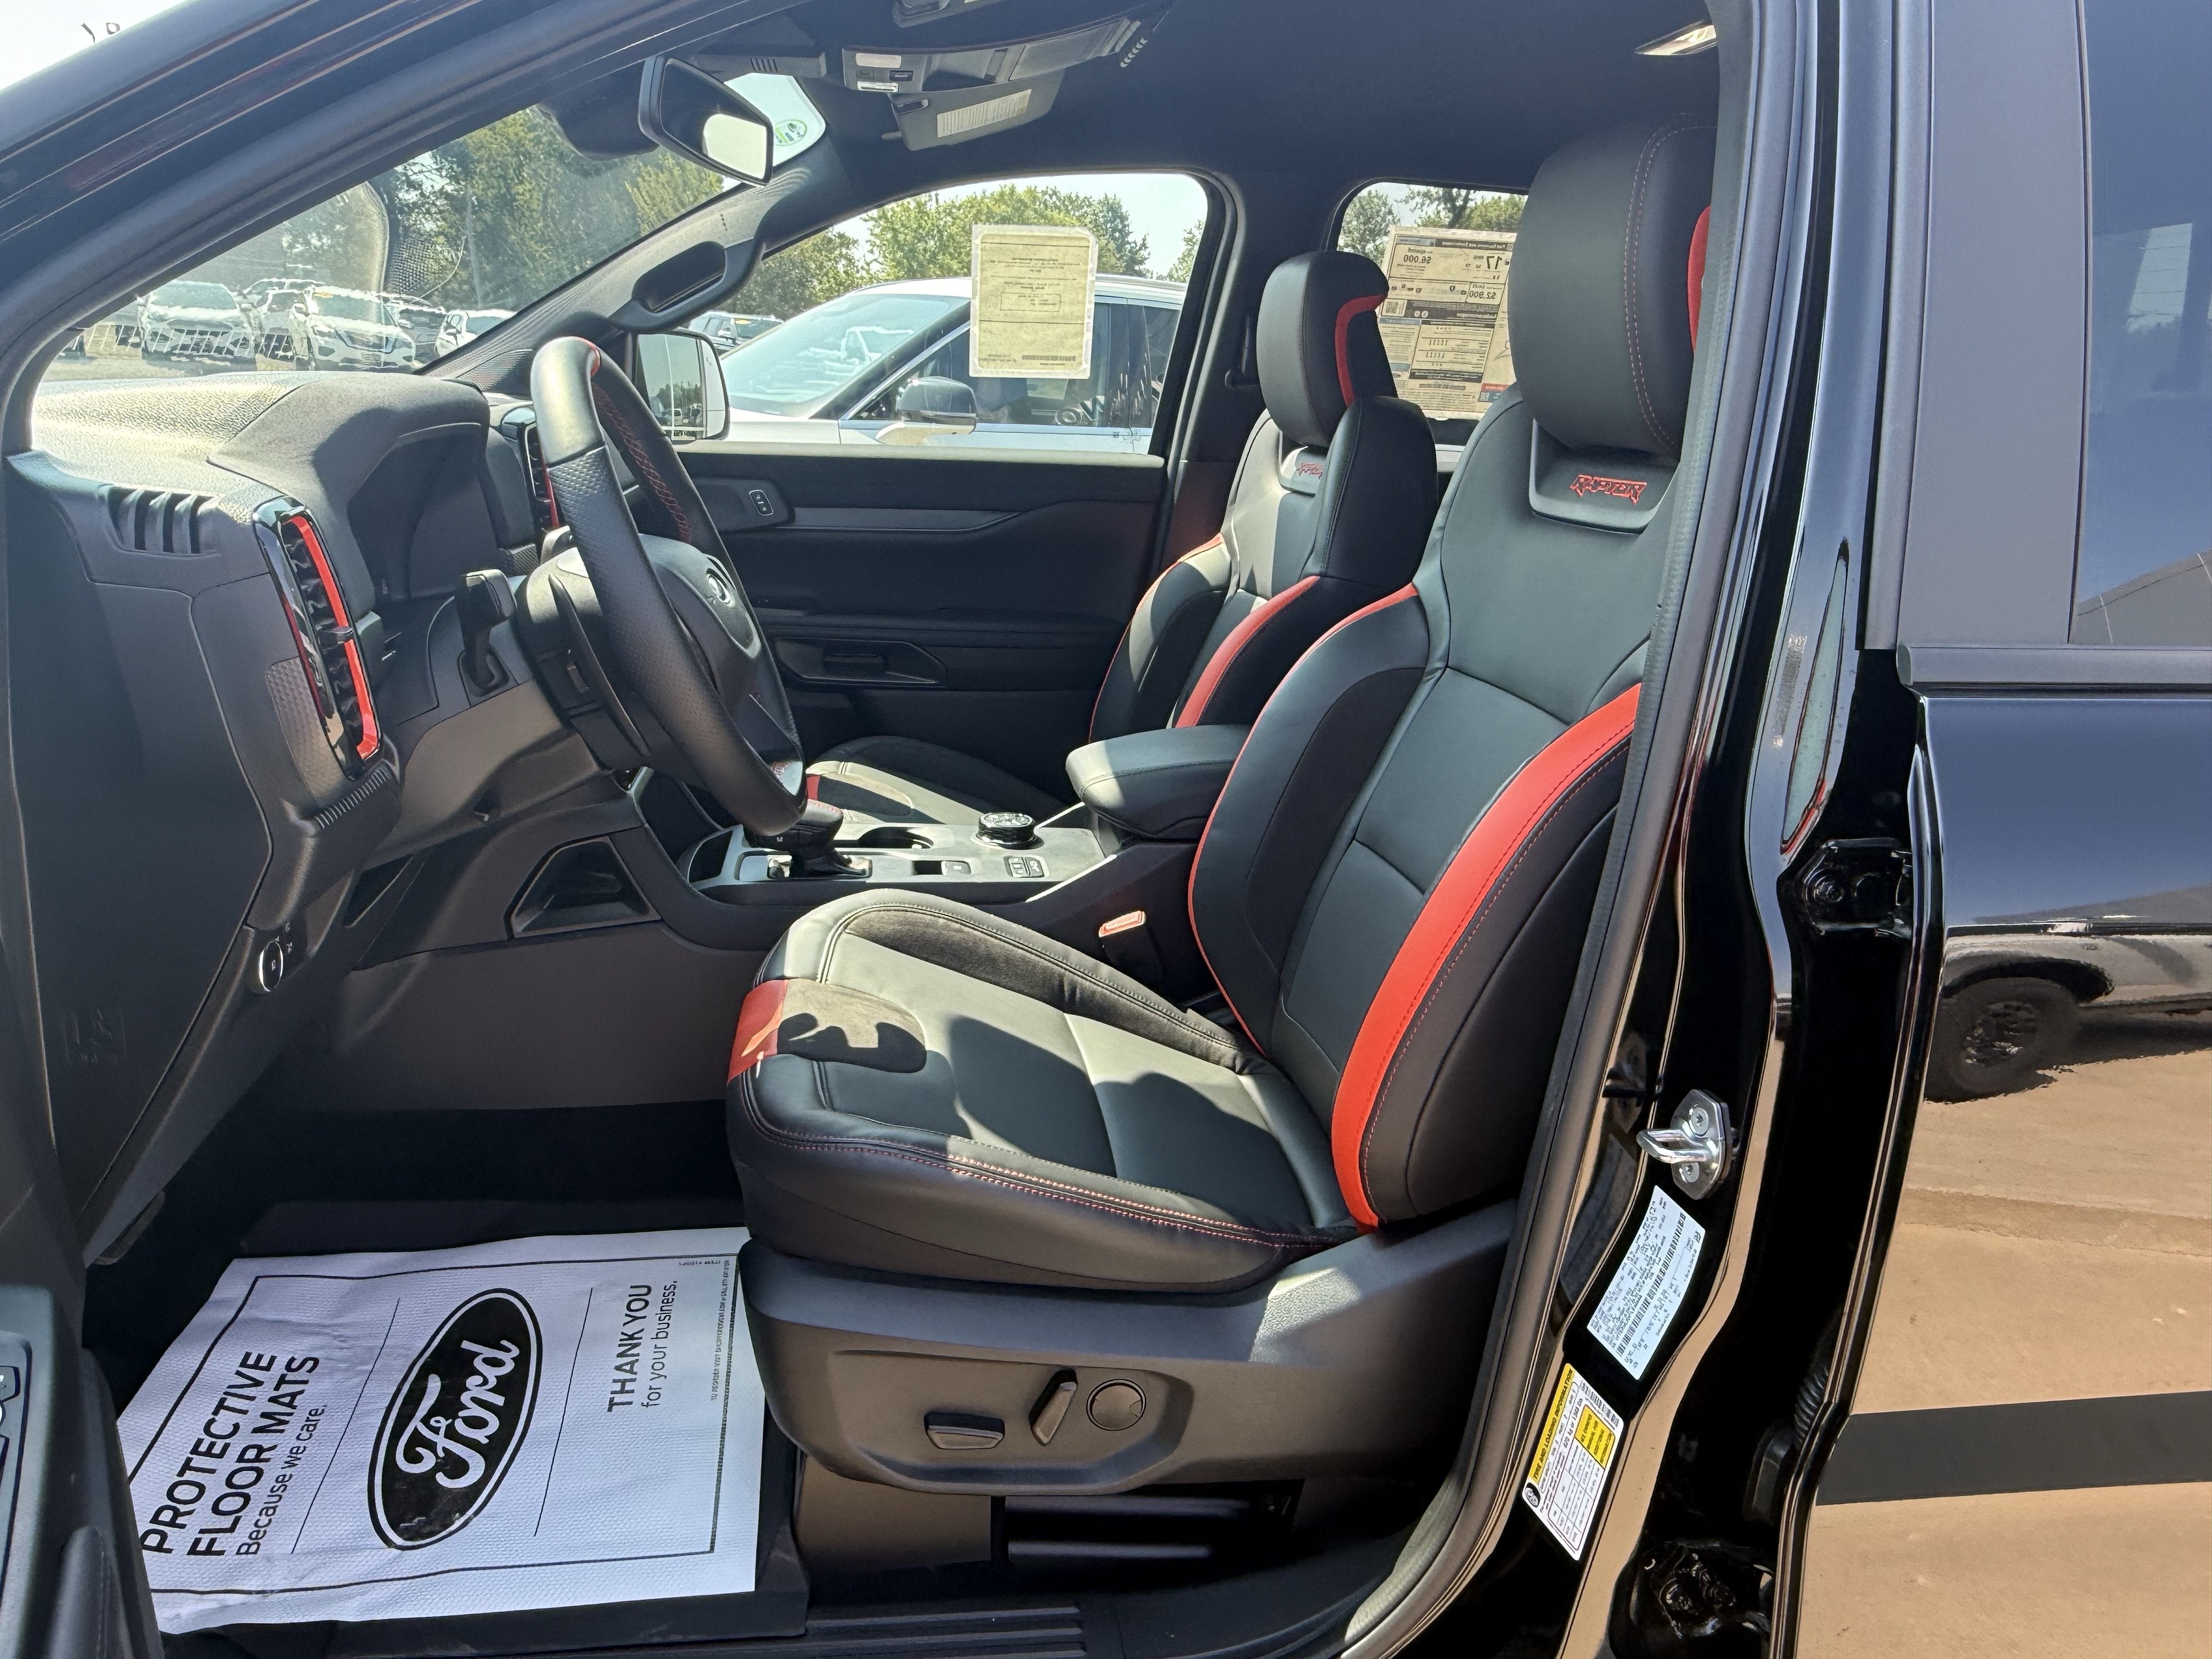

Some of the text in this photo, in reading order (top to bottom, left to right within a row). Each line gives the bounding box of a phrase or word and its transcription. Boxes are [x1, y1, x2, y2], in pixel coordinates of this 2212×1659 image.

[396, 1340, 520, 1488] Ford
[607, 1284, 652, 1413] THANK YOU
[641, 1280, 678, 1408] for your business.
[140, 1351, 278, 1554] PROTECTIVE
[187, 1356, 320, 1556] FLOOR MATS
[235, 1404, 328, 1555] Because we care.
